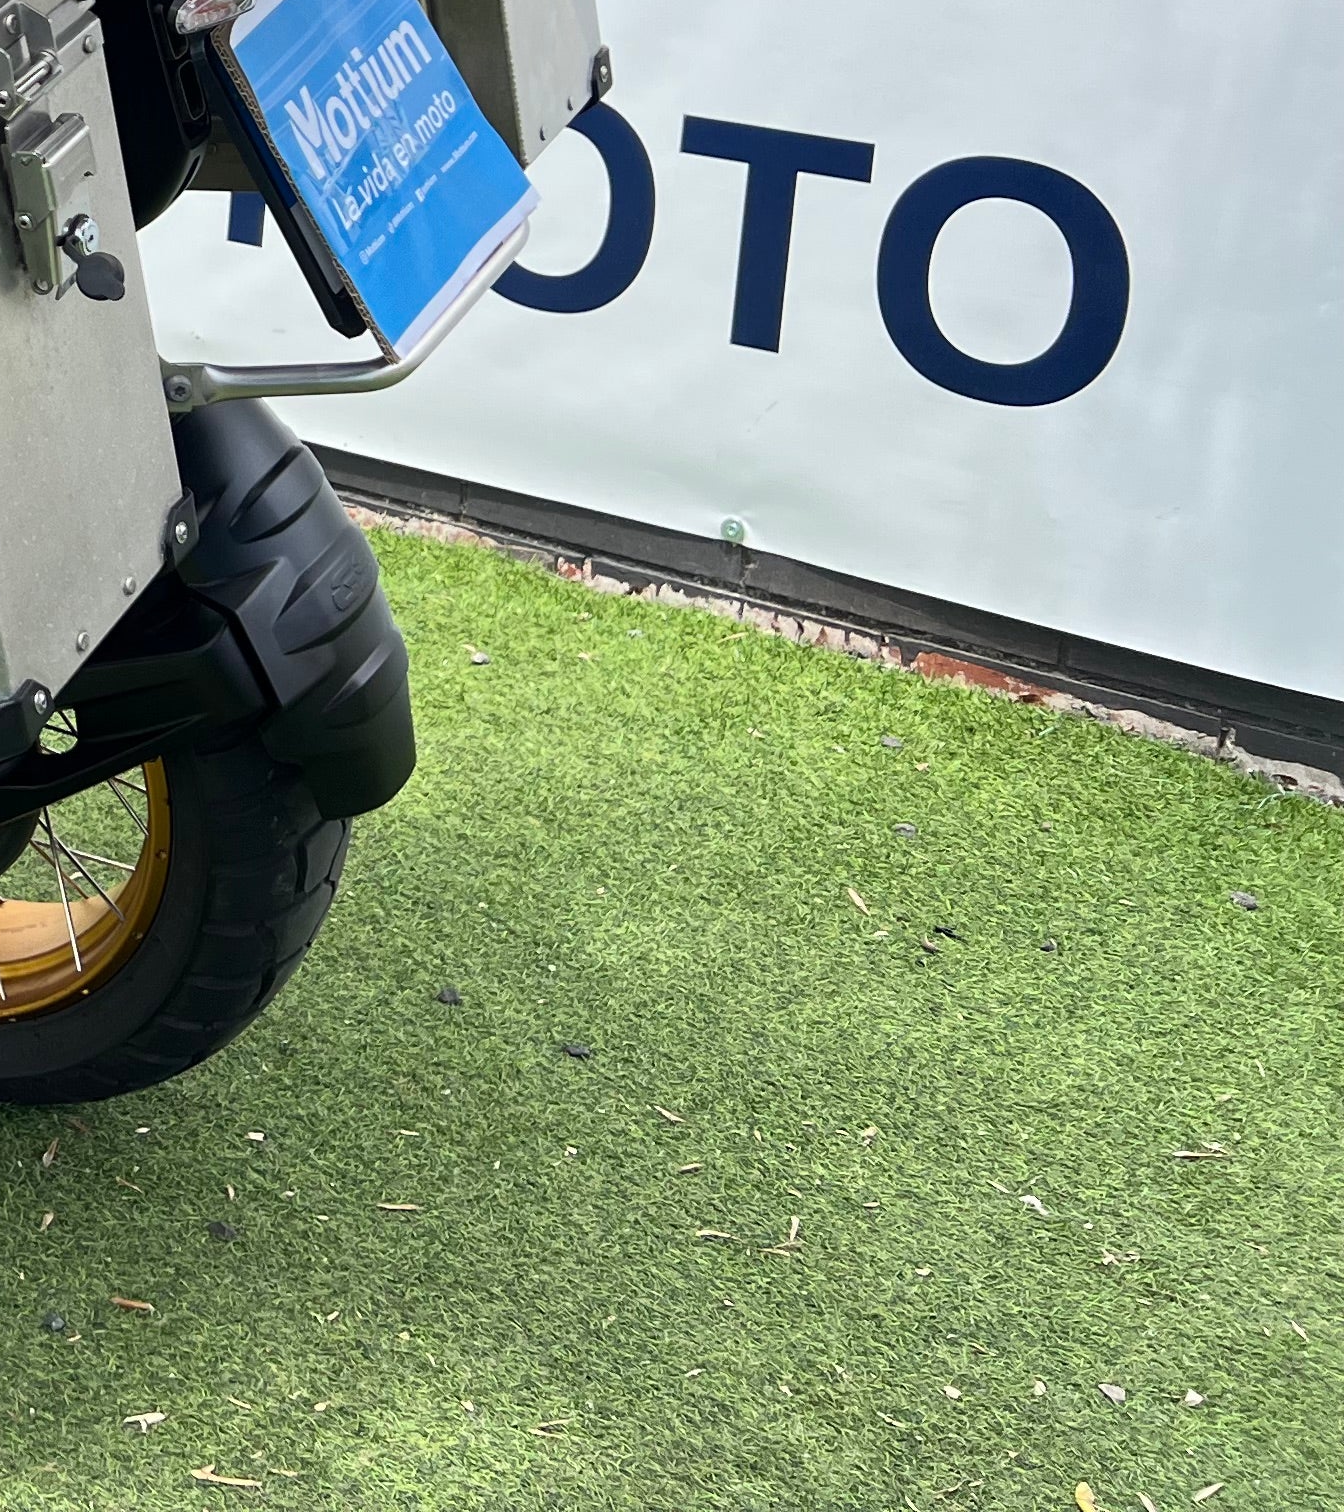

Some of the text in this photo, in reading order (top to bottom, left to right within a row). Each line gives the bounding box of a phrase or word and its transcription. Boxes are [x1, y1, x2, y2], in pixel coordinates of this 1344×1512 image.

[283, 19, 433, 180] Mottium
[330, 192, 365, 231] La
[357, 152, 397, 207] vida
[393, 132, 419, 167] en
[413, 89, 457, 145] moto
[227, 99, 1131, 408] OTO
